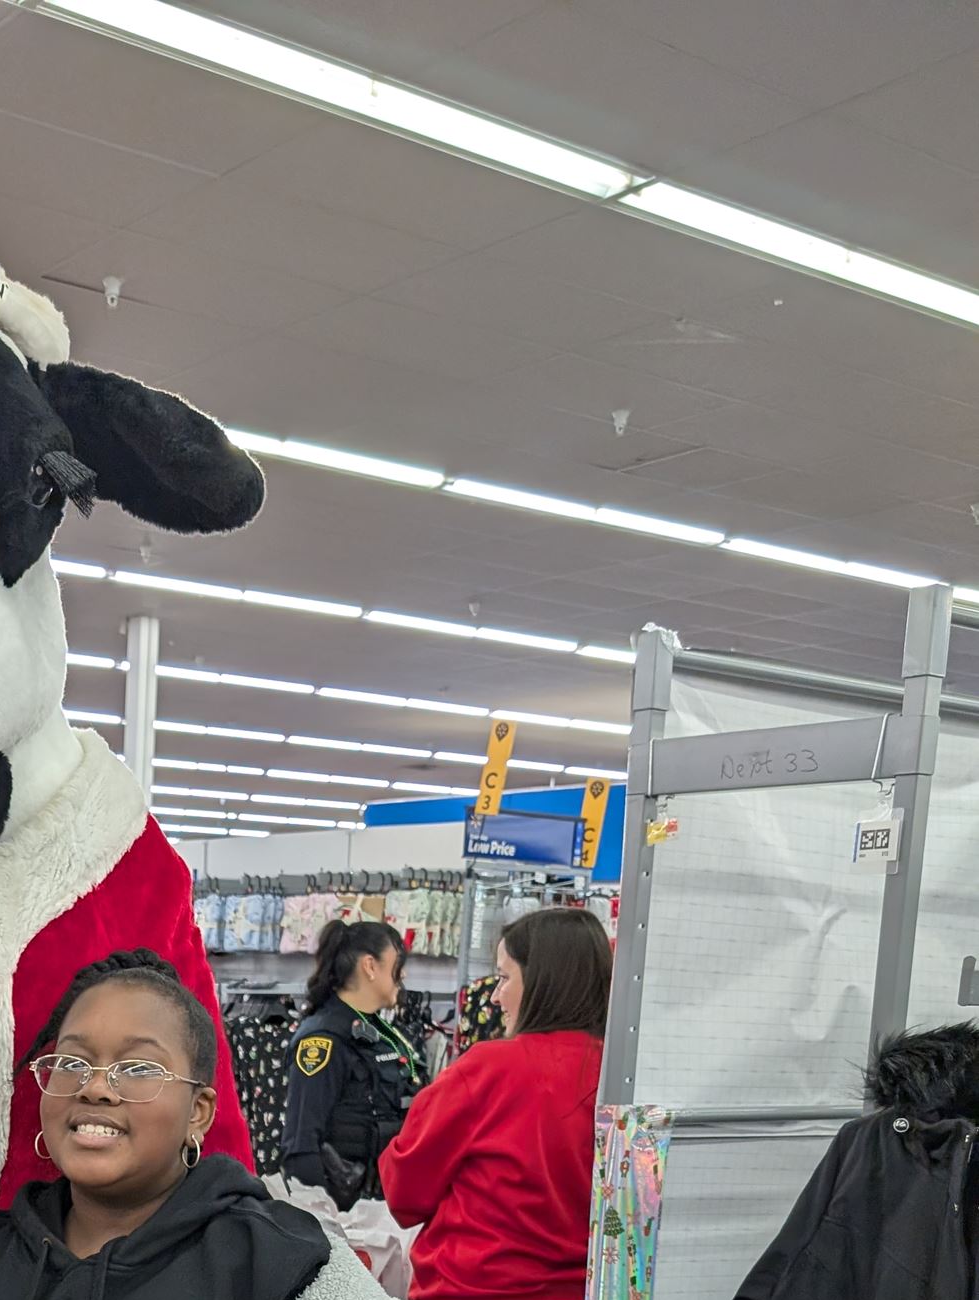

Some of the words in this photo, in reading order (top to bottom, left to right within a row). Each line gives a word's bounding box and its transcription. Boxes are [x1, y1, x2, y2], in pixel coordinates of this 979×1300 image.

[784, 749, 819, 773] 33
[485, 772, 498, 789] C
[481, 795, 491, 810] 3
[583, 827, 595, 843] C
[468, 839, 490, 855] Low
[490, 840, 516, 857] Price
